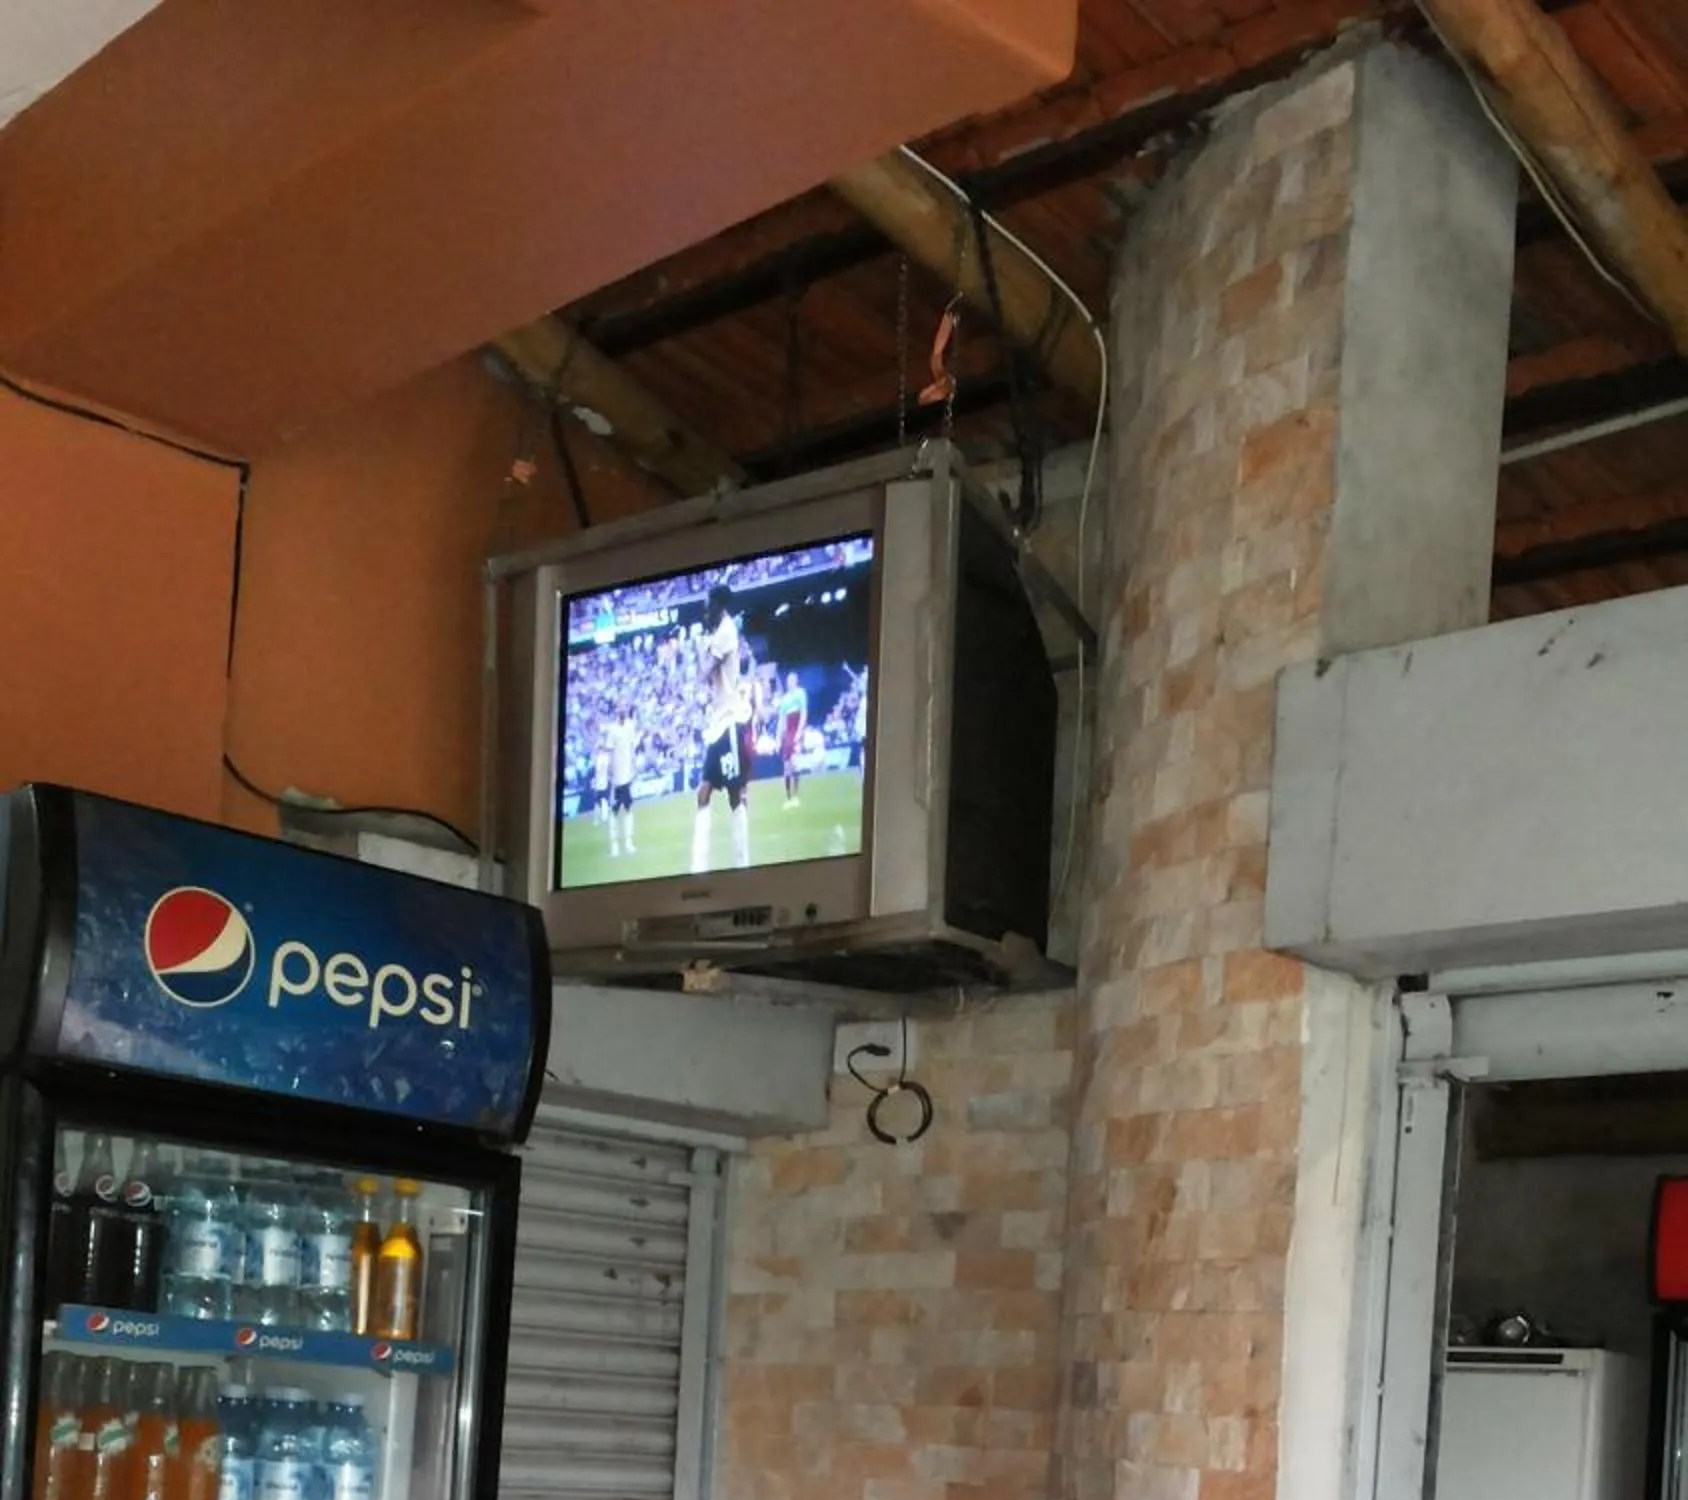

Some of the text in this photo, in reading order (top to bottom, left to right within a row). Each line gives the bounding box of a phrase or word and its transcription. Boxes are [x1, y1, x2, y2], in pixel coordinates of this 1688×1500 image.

[268, 940, 471, 1029] pepsi
[113, 1319, 159, 1337] pepsi
[260, 1335, 303, 1352] pepsi
[394, 1350, 436, 1364] pepsi
